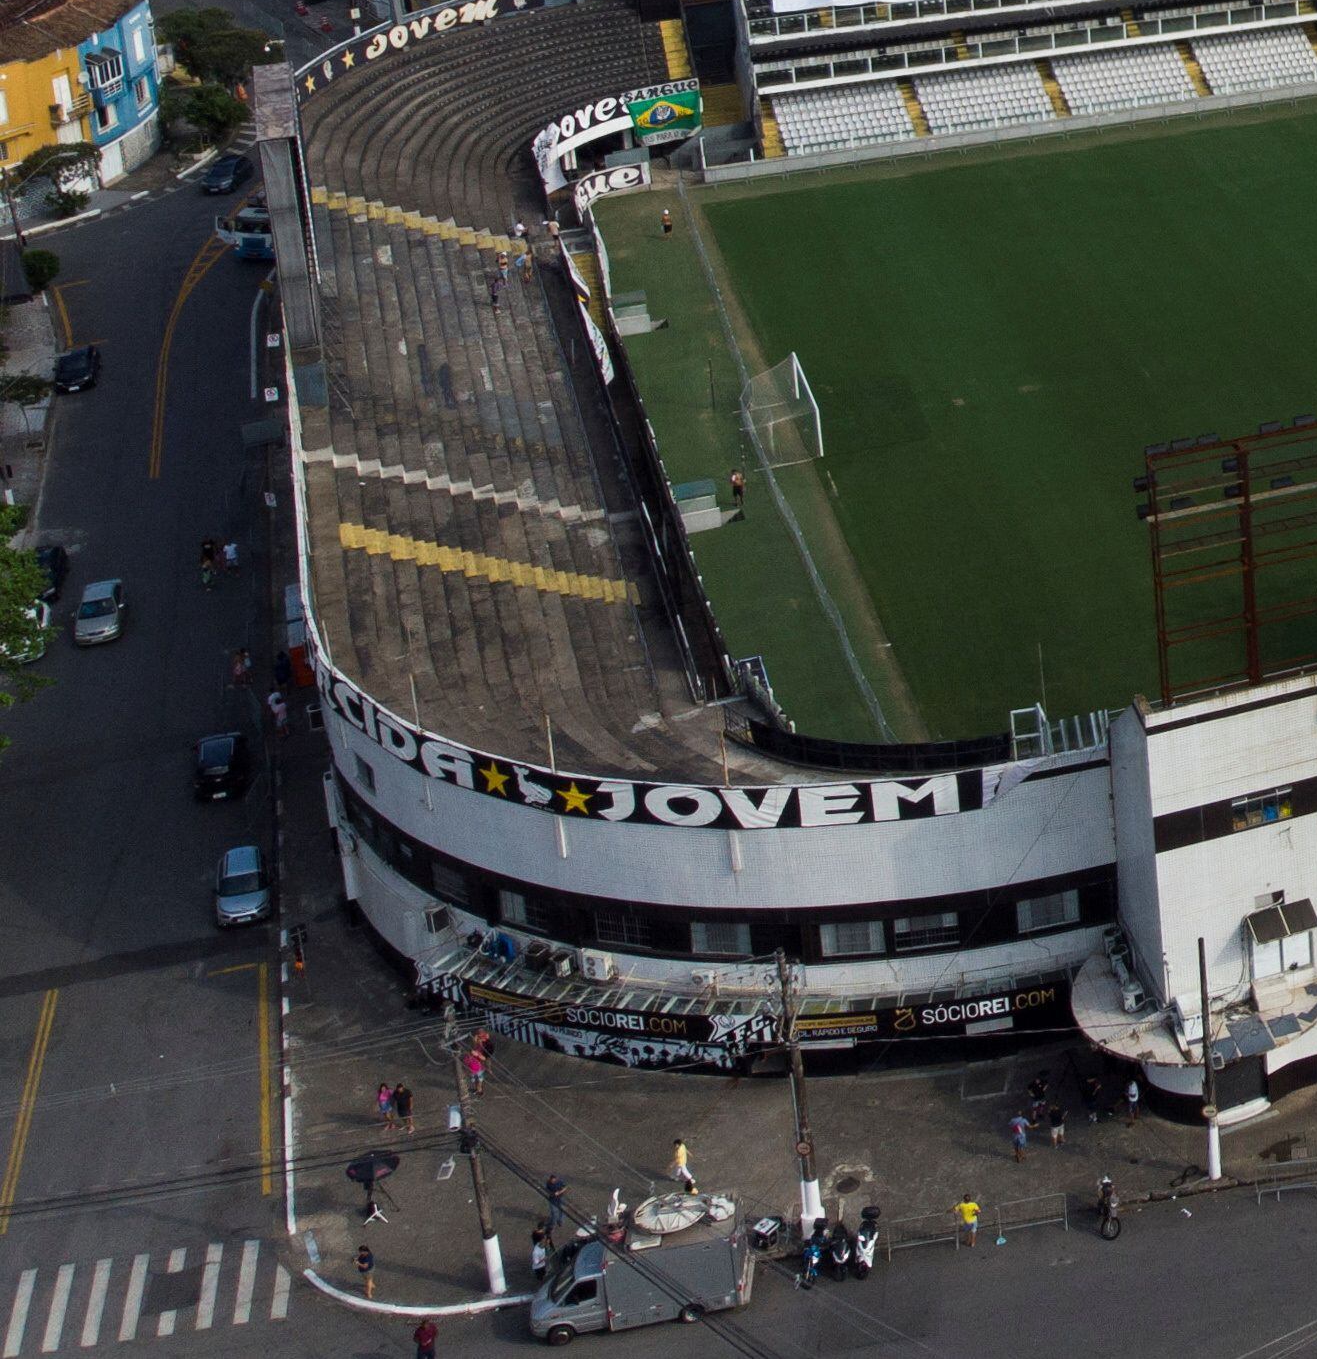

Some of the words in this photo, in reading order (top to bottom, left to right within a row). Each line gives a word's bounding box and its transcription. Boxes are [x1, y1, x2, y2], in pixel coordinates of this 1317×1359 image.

[596, 775, 960, 829] JOVEM
[565, 1006, 687, 1034] SÓCIOREI.COM
[922, 988, 1056, 1025] SÓCIOREI.COM
